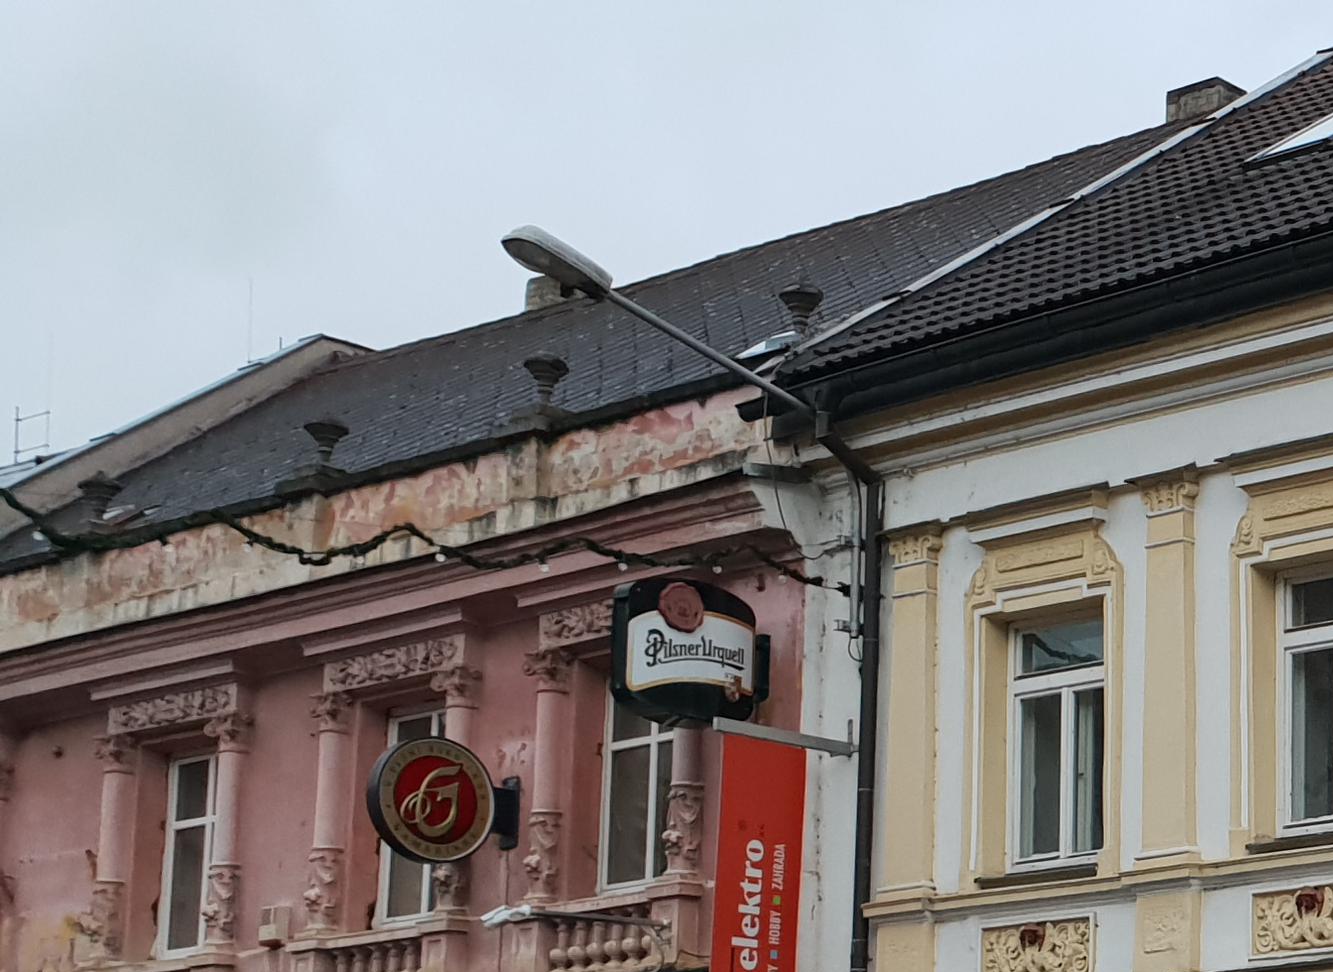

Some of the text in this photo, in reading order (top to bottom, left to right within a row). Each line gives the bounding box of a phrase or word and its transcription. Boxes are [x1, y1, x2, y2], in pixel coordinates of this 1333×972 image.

[644, 629, 745, 668] Pilsner Urquell
[771, 843, 787, 891] ZAHRADA
[731, 839, 765, 971] elektro
[768, 910, 782, 945] HOBBY
